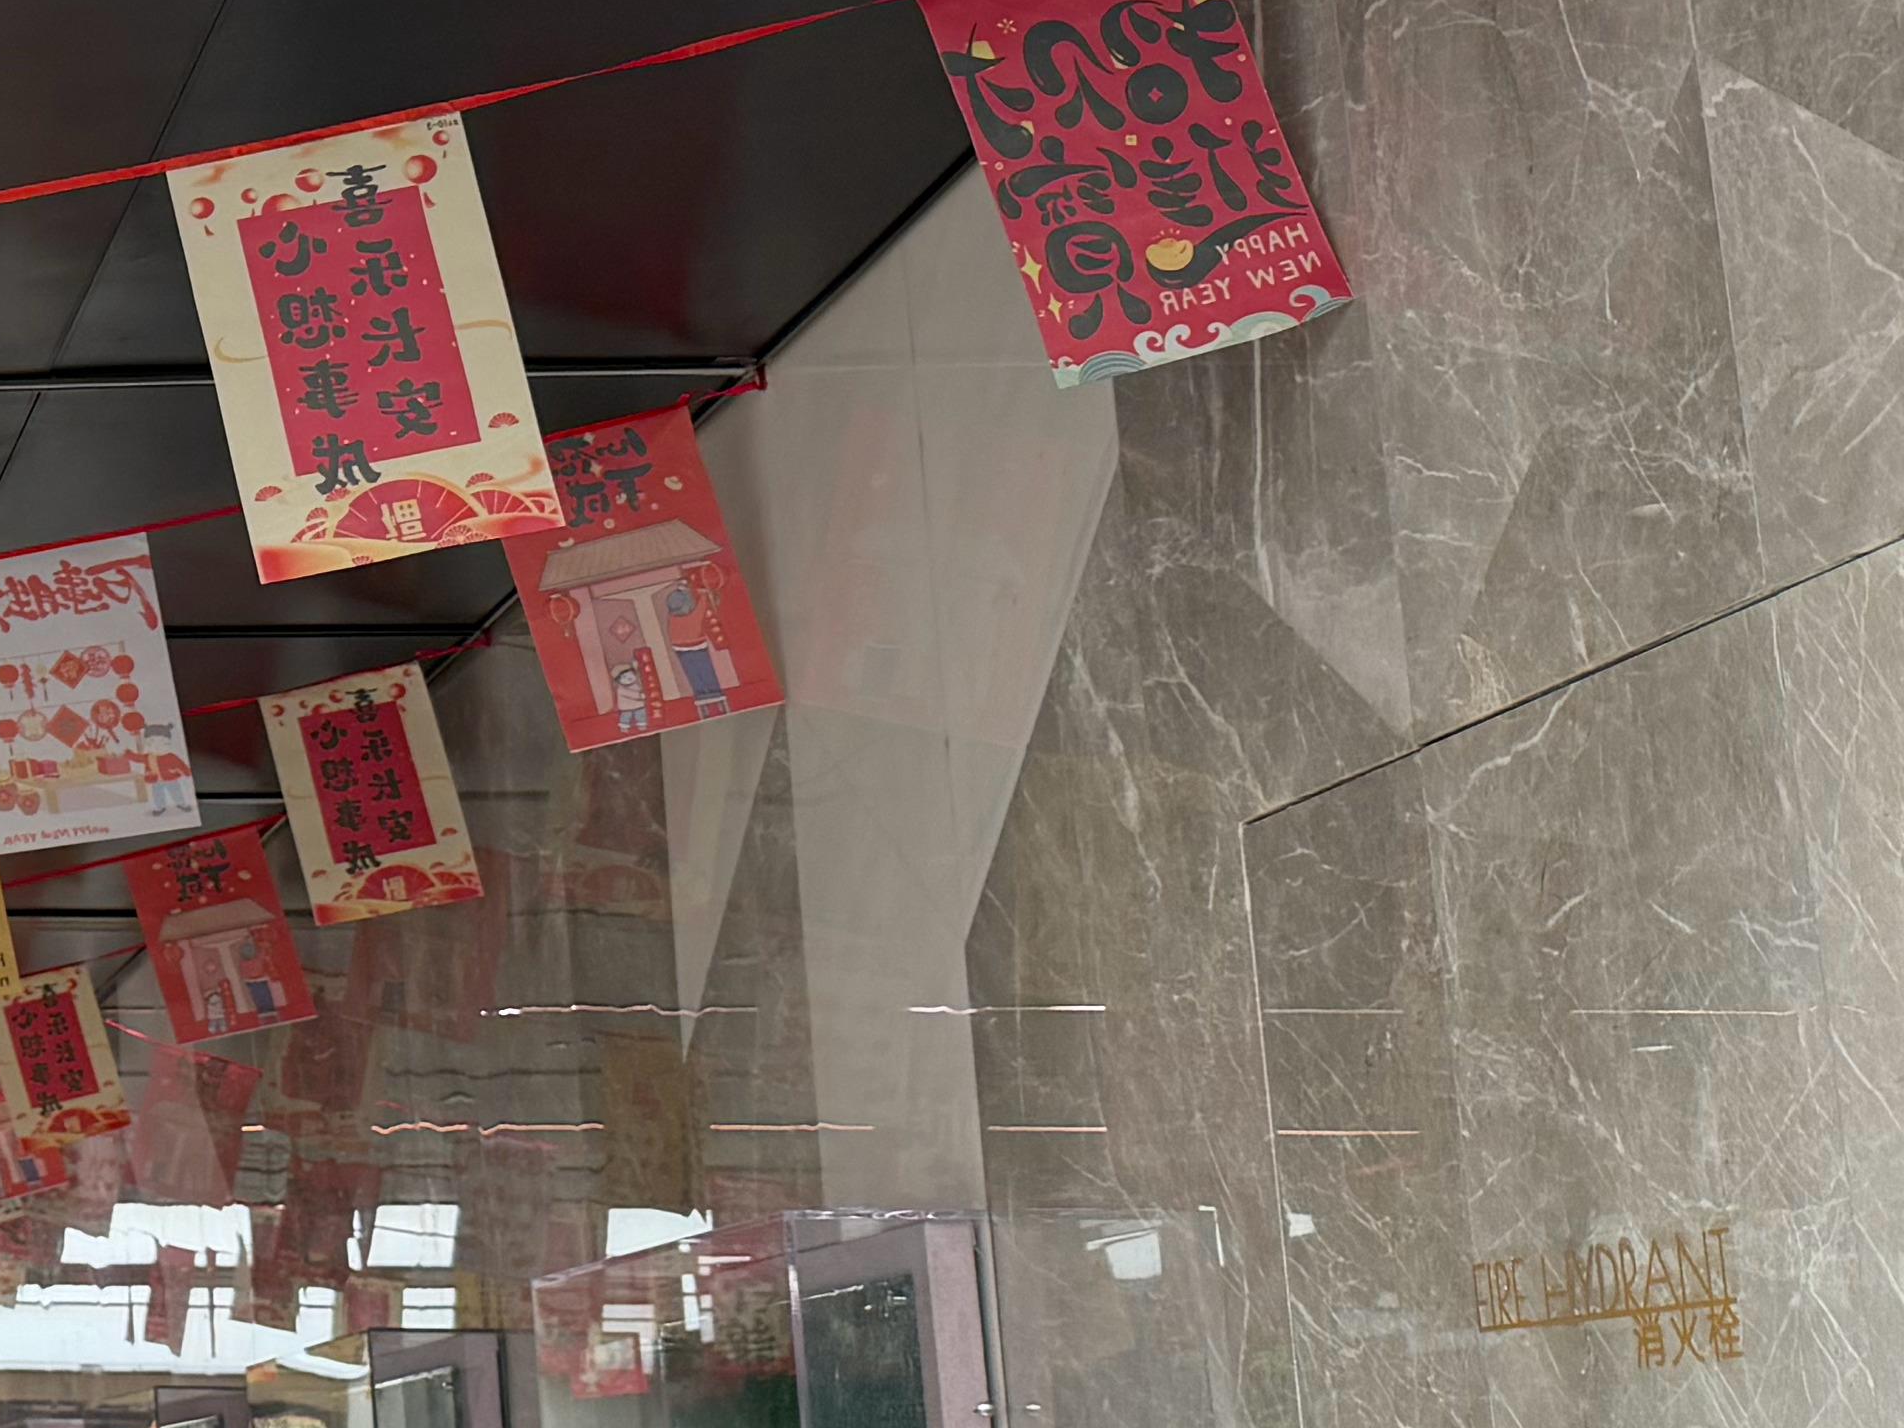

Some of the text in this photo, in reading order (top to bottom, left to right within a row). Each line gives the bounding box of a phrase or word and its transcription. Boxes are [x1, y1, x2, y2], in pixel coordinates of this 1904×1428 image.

[1473, 1228, 1729, 1329] FIRE HYDRANT
[1635, 1311, 1745, 1368] 消火栓
